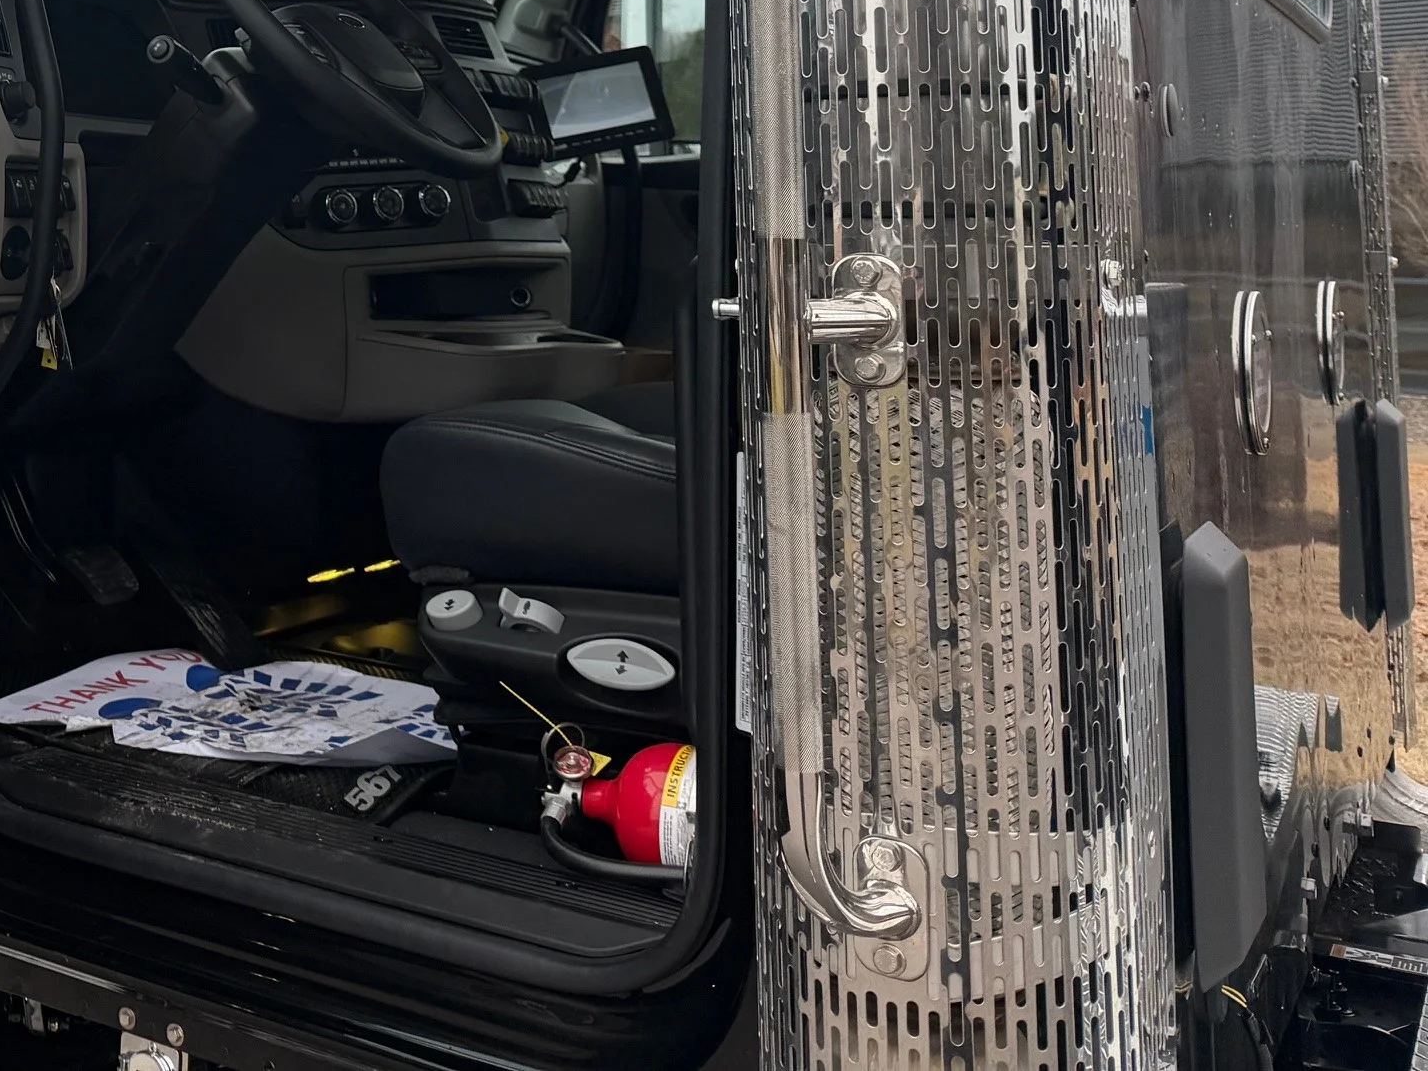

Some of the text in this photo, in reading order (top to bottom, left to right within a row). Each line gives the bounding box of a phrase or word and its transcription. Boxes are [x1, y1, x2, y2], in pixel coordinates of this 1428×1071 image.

[23, 651, 202, 714] THANK YOU
[343, 764, 401, 812] 567
